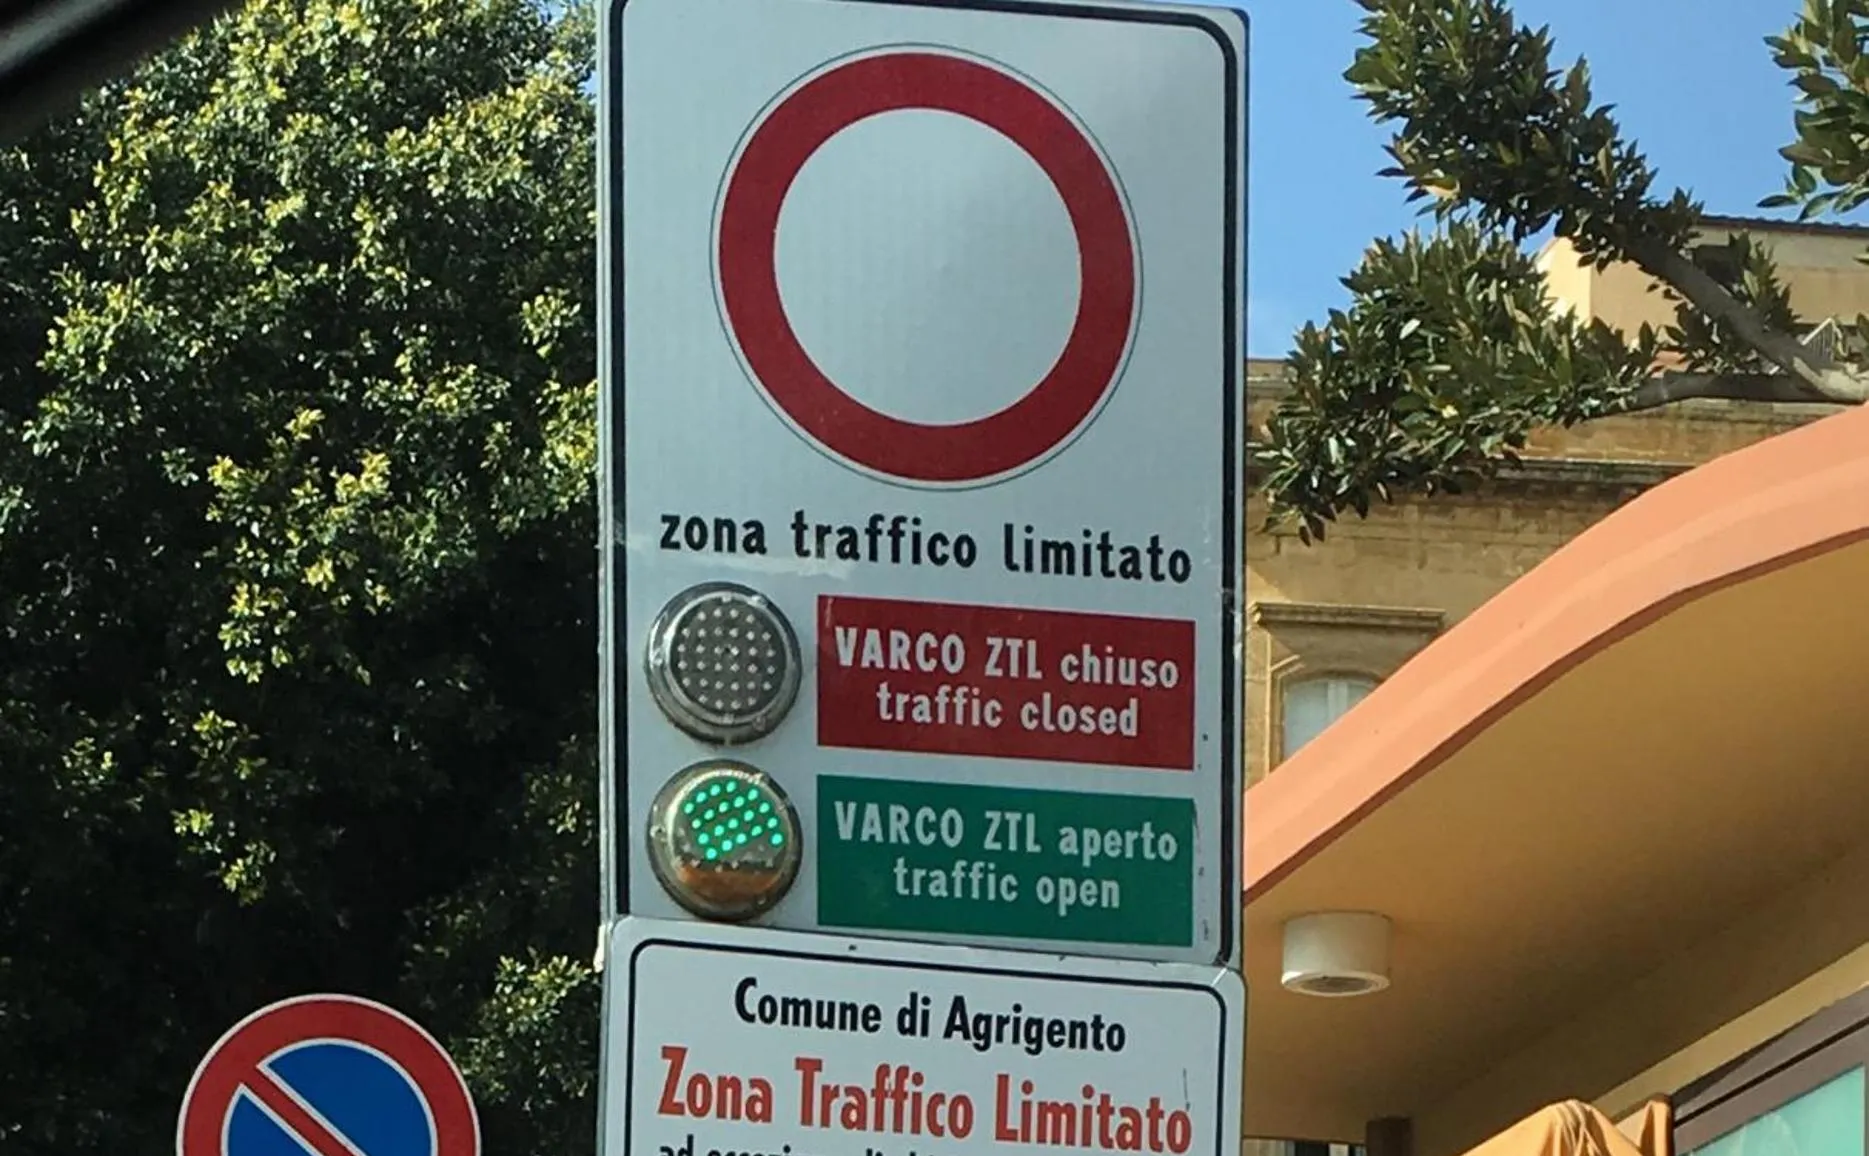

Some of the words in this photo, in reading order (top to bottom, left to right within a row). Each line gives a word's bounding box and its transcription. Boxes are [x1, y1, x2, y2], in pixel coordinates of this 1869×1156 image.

[659, 513, 768, 556] zona
[790, 509, 978, 569] traffico
[1003, 522, 1193, 585] limitato
[835, 626, 965, 674] VARCO
[984, 637, 1043, 679] ZTL
[1060, 643, 1179, 688] chiuso
[876, 681, 1002, 728] traffic
[1020, 691, 1138, 737] closed
[835, 801, 963, 847] VARCO
[984, 811, 1041, 852] ZTL
[1059, 822, 1177, 867] aperto
[893, 857, 1017, 901] traffic
[1036, 876, 1119, 916] open
[734, 976, 882, 1034] Comune
[896, 991, 932, 1038] di
[942, 994, 1126, 1057] Agrigento
[657, 1045, 773, 1124] Zona
[794, 1056, 974, 1140] Traffico
[994, 1073, 1192, 1155] Limitato
